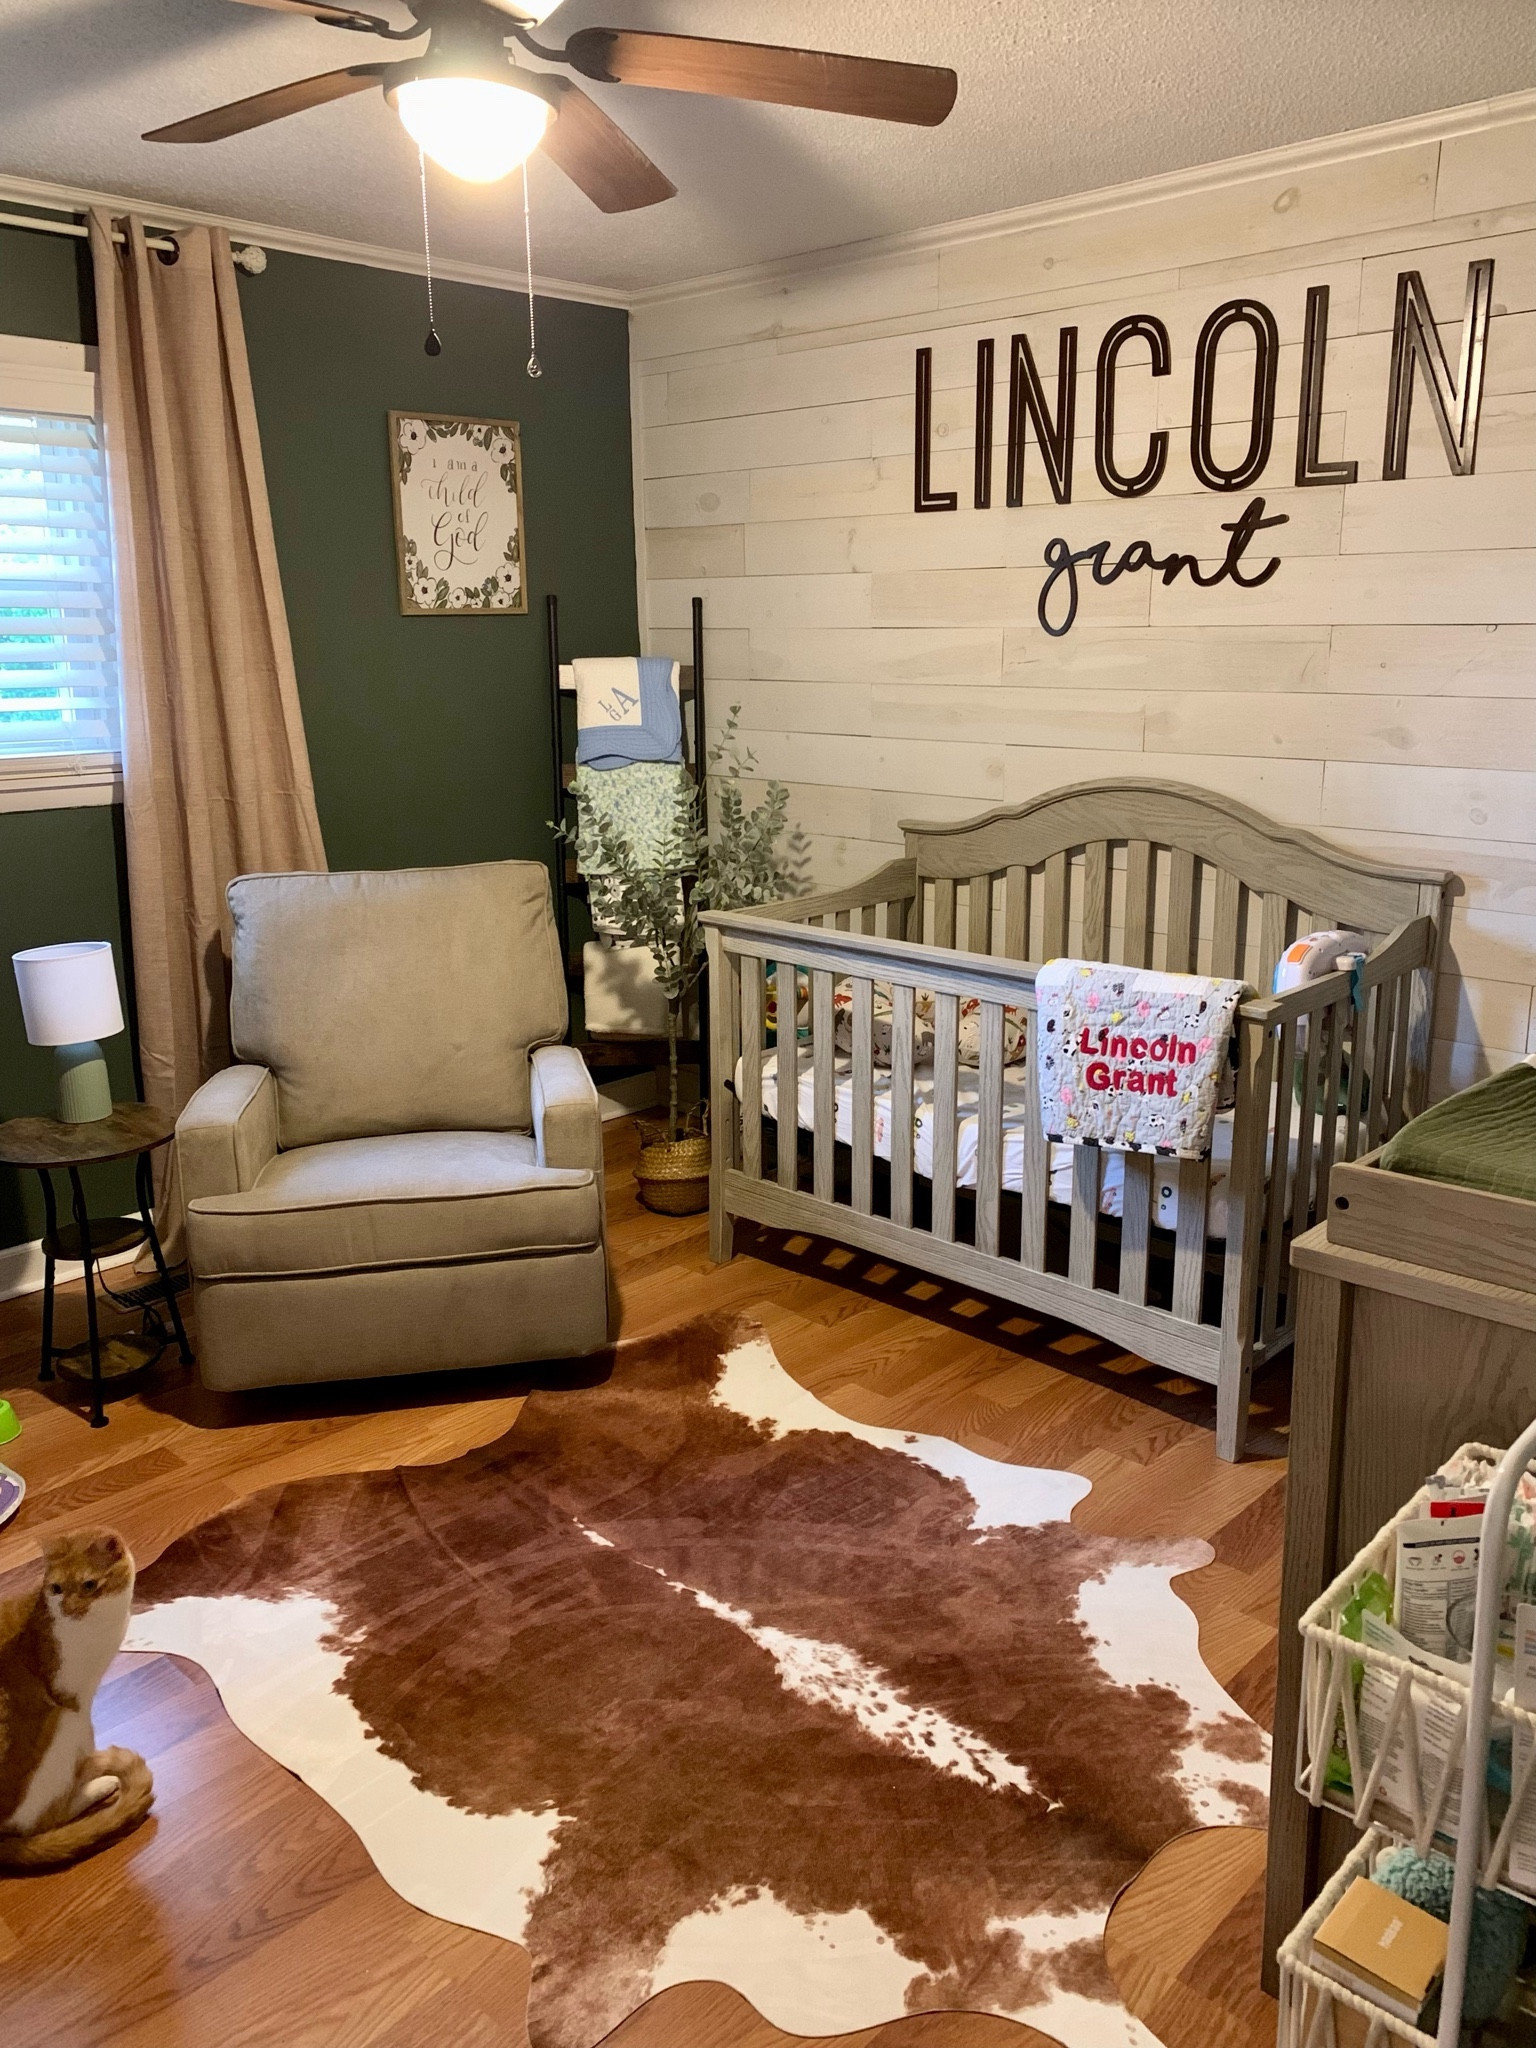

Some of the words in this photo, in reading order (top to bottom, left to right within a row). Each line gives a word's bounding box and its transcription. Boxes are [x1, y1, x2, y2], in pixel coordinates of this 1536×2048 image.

[914, 259, 1495, 512] LINCOLN
[421, 470, 489, 507] child
[431, 511, 489, 571] God
[1038, 497, 1289, 636] grant
[1080, 1027, 1197, 1064] Lincoln
[1086, 1062, 1178, 1097] Grant
